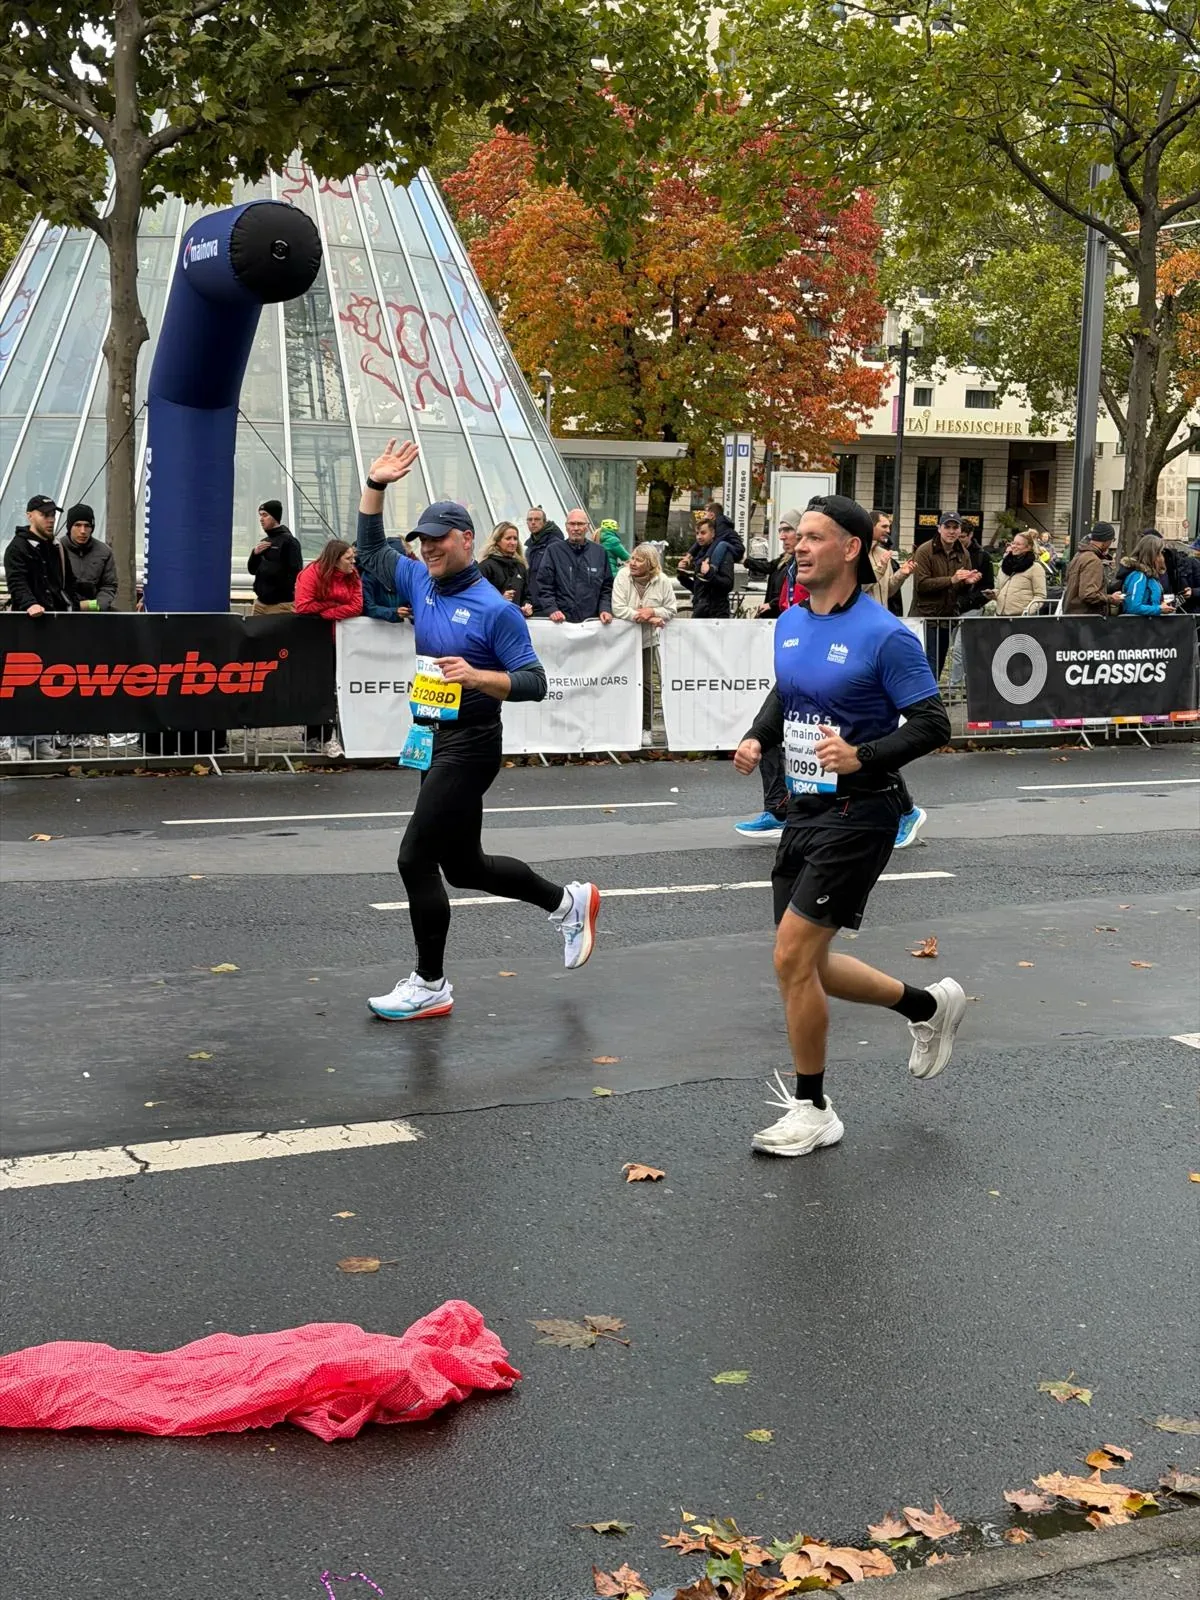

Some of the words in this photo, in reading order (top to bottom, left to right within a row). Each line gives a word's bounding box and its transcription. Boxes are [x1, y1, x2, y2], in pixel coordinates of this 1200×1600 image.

[190, 237, 219, 263] mainova
[906, 412, 931, 434] TAJ
[935, 419, 1022, 434] HESSISCHER
[1056, 649, 1115, 661] EUROPEAN
[1118, 647, 1177, 660] MARATHON
[0, 651, 278, 698] Powerbar
[1065, 661, 1167, 685] CLASSICS
[549, 677, 598, 687] PREMIUM
[601, 676, 628, 686] CARS
[671, 678, 770, 691] DEFENDER
[412, 687, 456, 704] 51208D
[416, 704, 441, 718] HOKA
[792, 780, 820, 794] HOKA
